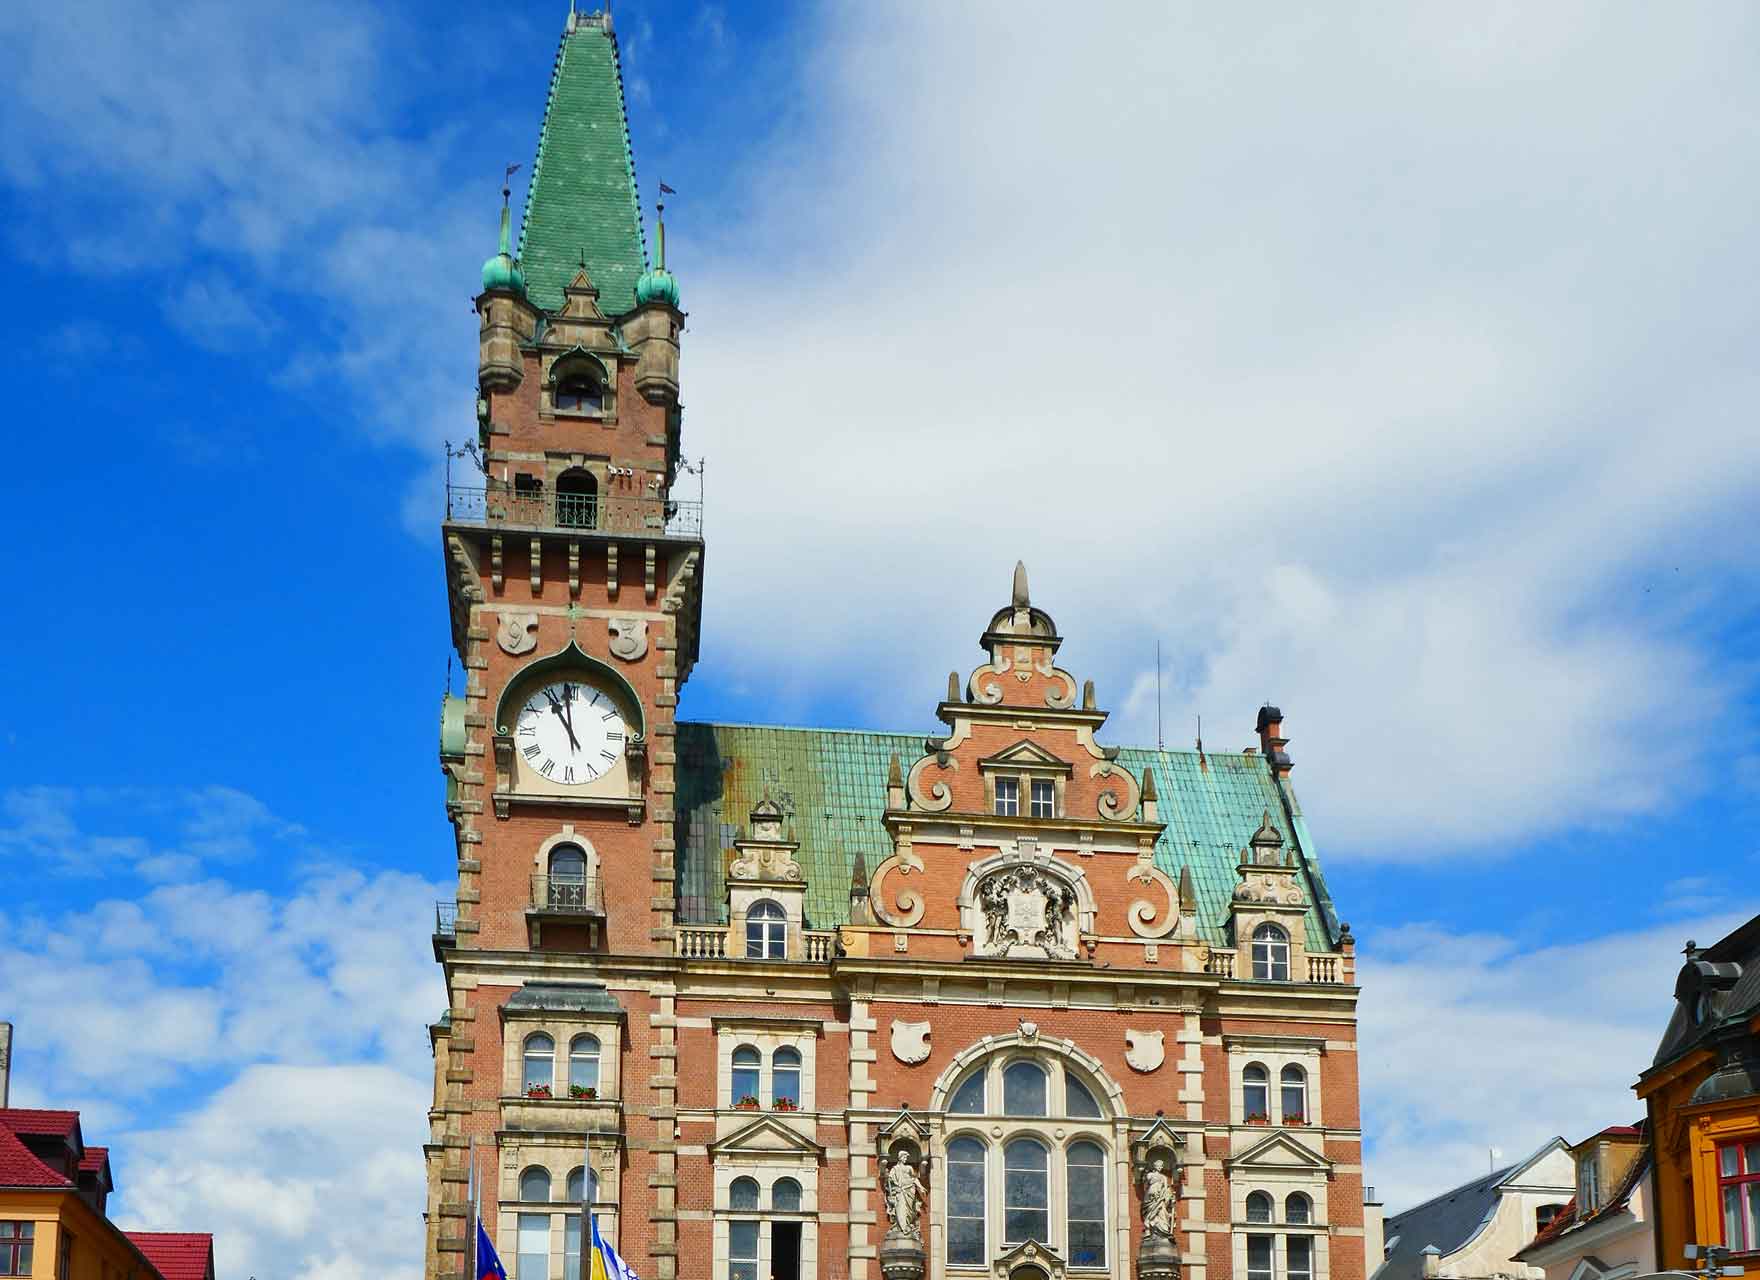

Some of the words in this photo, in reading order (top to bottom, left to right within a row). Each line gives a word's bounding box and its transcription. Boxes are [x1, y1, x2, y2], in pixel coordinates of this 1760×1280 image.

[526, 703, 543, 718] X
[601, 706, 618, 721] II
[519, 725, 536, 736] IX
[606, 731, 622, 741] III
[564, 765, 575, 784] VI
[587, 762, 598, 778] V
